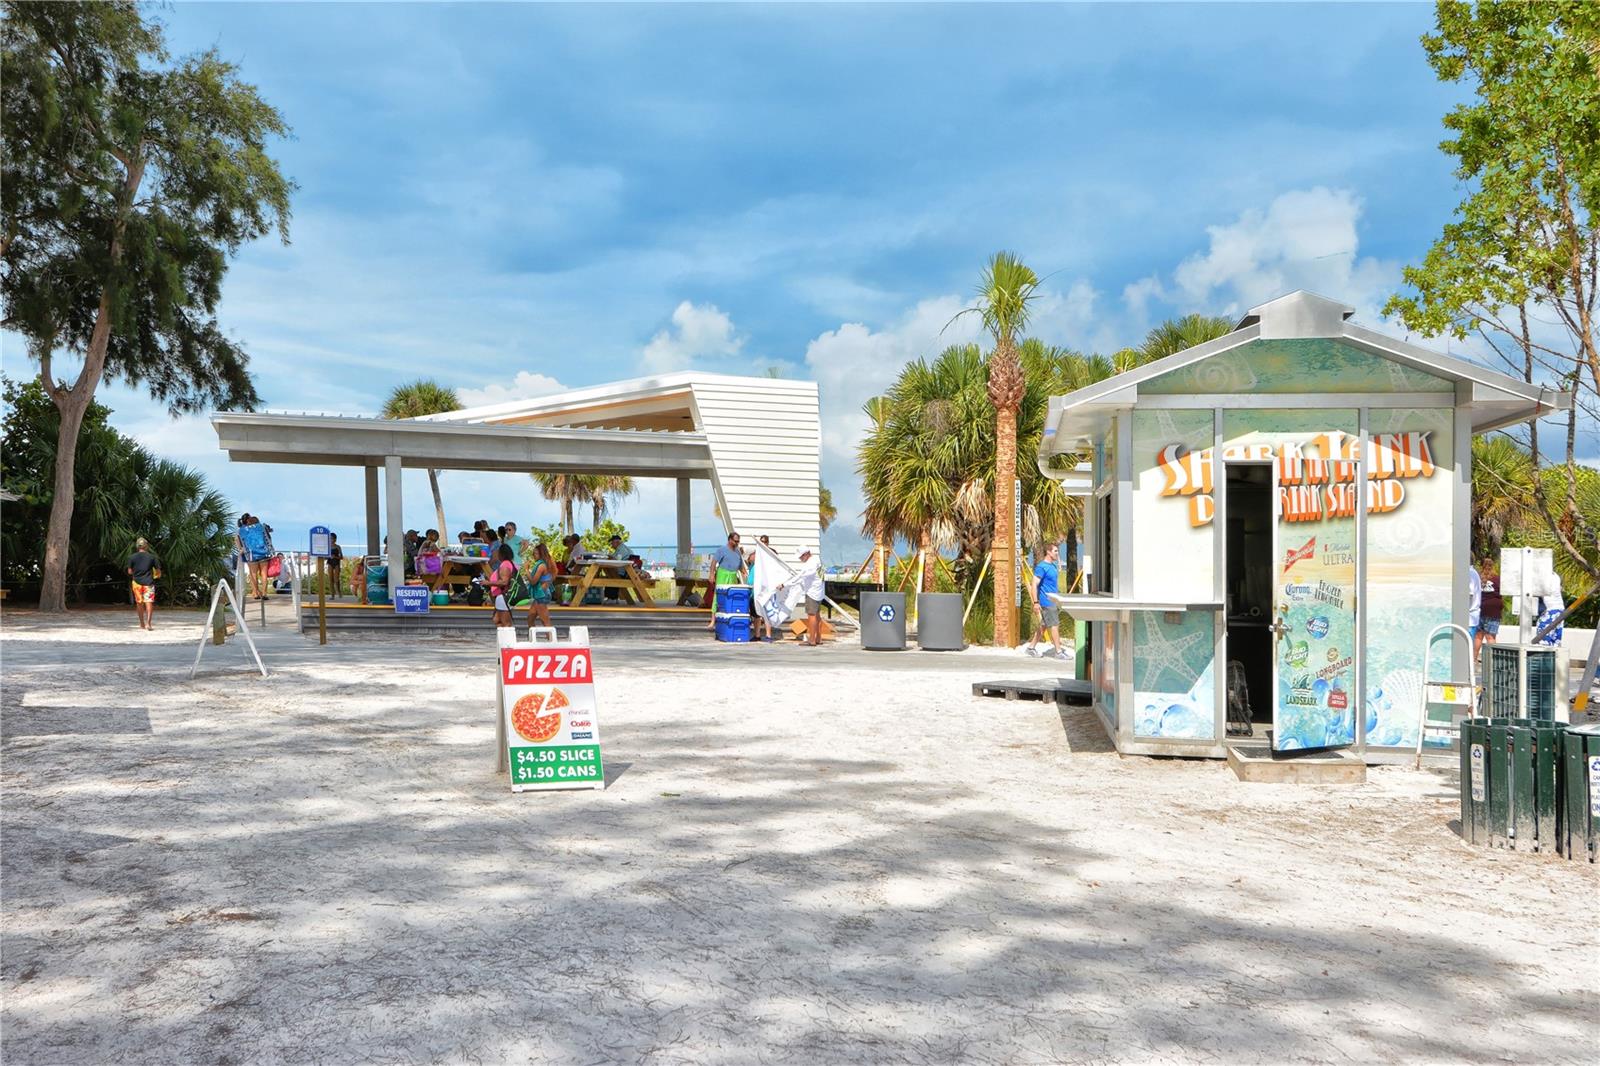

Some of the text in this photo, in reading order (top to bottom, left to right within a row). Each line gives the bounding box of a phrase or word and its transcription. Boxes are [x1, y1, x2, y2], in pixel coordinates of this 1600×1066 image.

[1326, 478, 1405, 518] STAND
[1323, 553, 1354, 566] ULTRA
[396, 589, 427, 597] RESERVED
[1285, 583, 1312, 595] Corona
[508, 654, 587, 679] PIZZA
[1316, 657, 1352, 679] LONGBOARD
[517, 749, 595, 764] $4.50 SLICE
[518, 765, 597, 780] $1.50 CANS
